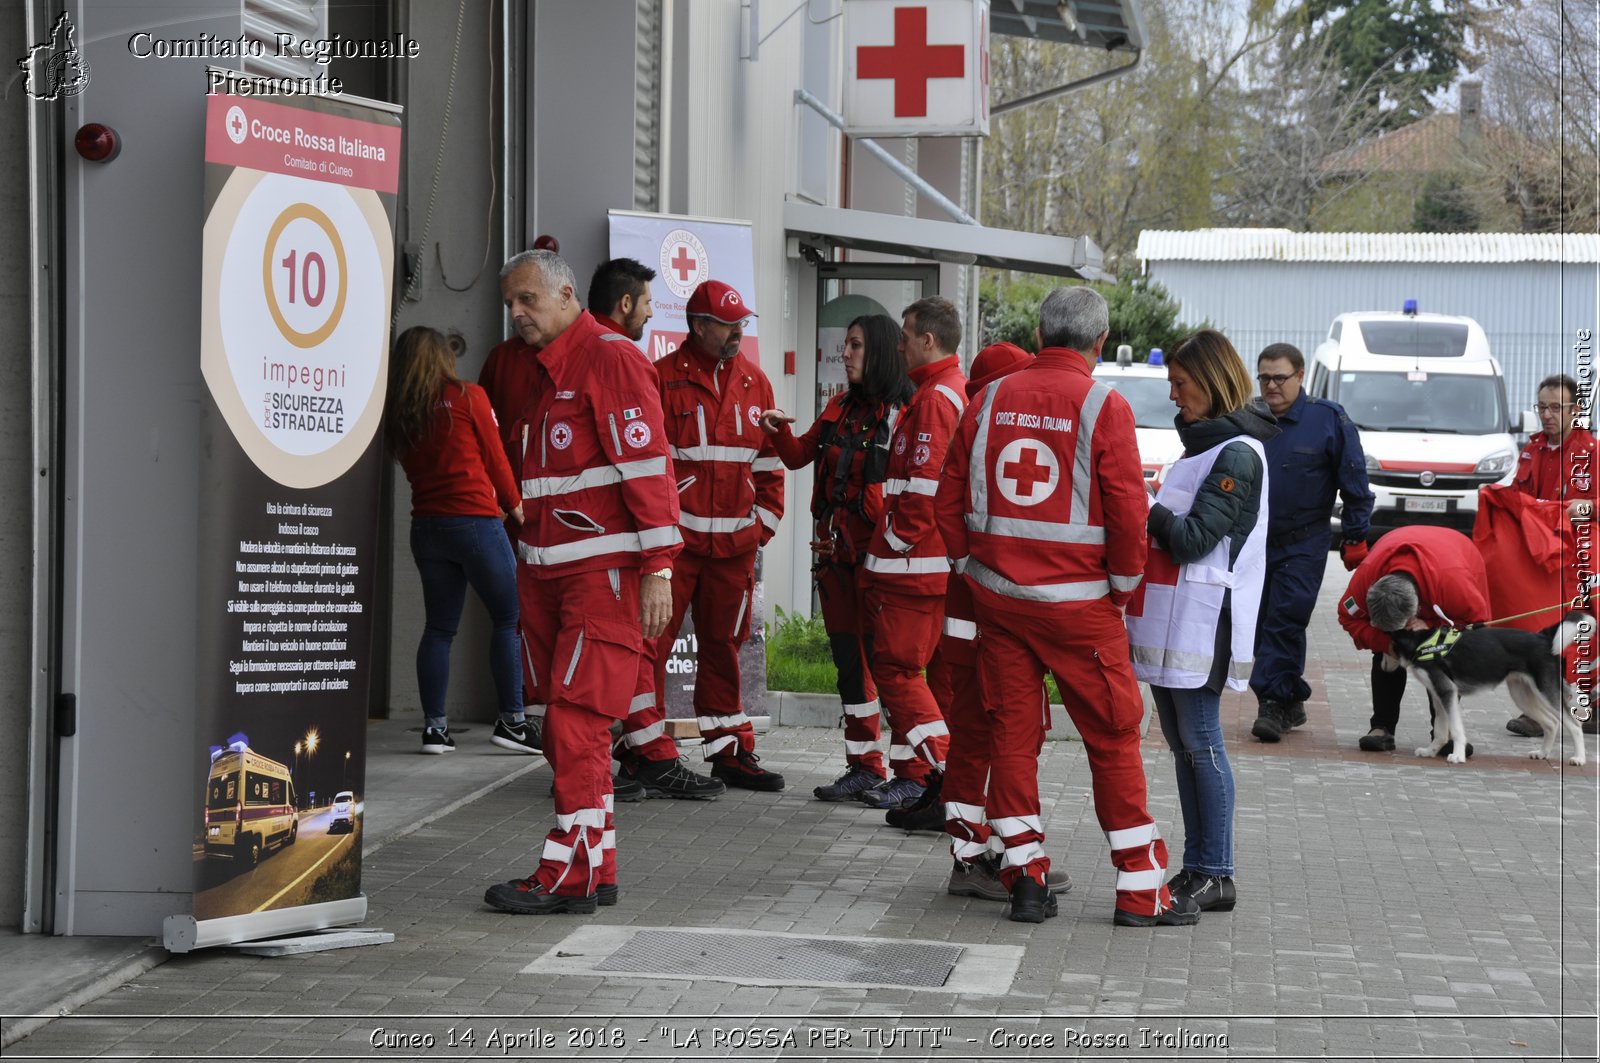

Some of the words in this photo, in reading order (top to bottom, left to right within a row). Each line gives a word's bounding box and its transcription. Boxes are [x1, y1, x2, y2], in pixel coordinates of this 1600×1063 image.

[252, 119, 291, 144] Croce
[295, 128, 335, 152] Rossa
[339, 136, 385, 161] Italiana
[284, 154, 316, 171] Comitato
[319, 161, 326, 173] di
[328, 162, 353, 177] Cuneo
[282, 249, 326, 307] 10
[655, 301, 673, 309] Croce
[654, 334, 677, 360] Ne
[826, 355, 844, 363] INFO
[264, 356, 345, 391] impegni
[264, 392, 271, 403] la
[272, 392, 344, 415] SICUREZZA
[273, 412, 343, 433] STRADALE
[996, 412, 1016, 425] CROCE
[1017, 413, 1040, 428] ROSSA
[1042, 416, 1072, 432] ITALIANA
[267, 502, 276, 514] Usa
[277, 502, 282, 514] la
[283, 503, 301, 515] cintura
[302, 504, 307, 515] di
[308, 504, 332, 516] sicurezza
[278, 522, 298, 534] Indossa
[299, 523, 302, 535] il
[303, 526, 319, 535] casco
[240, 540, 258, 552] Modera
[258, 541, 263, 553] la
[264, 541, 280, 553] velocità
[281, 545, 284, 553] e
[285, 543, 305, 554] mantieni
[306, 542, 310, 554] la
[311, 542, 330, 555] distanza
[331, 543, 335, 555] di
[336, 544, 356, 556] sicurezza
[236, 561, 246, 573] Non
[247, 564, 270, 573] assumere
[271, 561, 286, 573] alcool
[286, 564, 290, 573] o
[291, 562, 320, 576] stupefacenti
[321, 563, 335, 576] prima
[336, 562, 341, 574] di
[342, 563, 359, 577] guidare
[239, 581, 249, 592] Non
[250, 584, 264, 592] usare
[265, 580, 269, 592] il
[270, 580, 291, 592] telefono
[292, 581, 313, 593] cellulare
[314, 581, 334, 593] durante
[336, 582, 340, 593] la
[341, 582, 355, 596] guida
[234, 600, 249, 612] visibile
[250, 600, 260, 612] sulla
[261, 601, 286, 615] carreggiata
[294, 604, 307, 612] come
[308, 601, 325, 615] pedone
[326, 601, 334, 612] che
[335, 604, 348, 612] come
[349, 601, 362, 612] ciclista
[244, 620, 261, 635] Impara
[262, 623, 266, 632] e
[267, 620, 287, 635] rispetta
[288, 620, 294, 632] le
[294, 623, 311, 632] norme
[312, 620, 317, 632] di
[318, 620, 347, 632] circolazione
[243, 640, 265, 651] Mantieni
[266, 640, 269, 651] il
[270, 641, 279, 651] tuo
[280, 639, 298, 651] veicolo
[299, 639, 304, 651] in
[305, 639, 321, 651] buone
[322, 639, 347, 650] condizioni
[230, 660, 243, 675] Segui
[244, 660, 248, 672] la
[249, 660, 276, 672] formazione
[277, 659, 303, 671] necessaria
[304, 661, 312, 673] per
[313, 660, 333, 671] ottenere
[334, 658, 338, 670] la
[339, 660, 356, 672] patente
[666, 655, 693, 674] che
[236, 681, 254, 695] Impara
[255, 683, 270, 692] come
[271, 680, 301, 694] comportarti
[303, 679, 307, 691] in
[308, 681, 320, 690] caso
[321, 678, 326, 690] di
[327, 678, 348, 689] incidente
